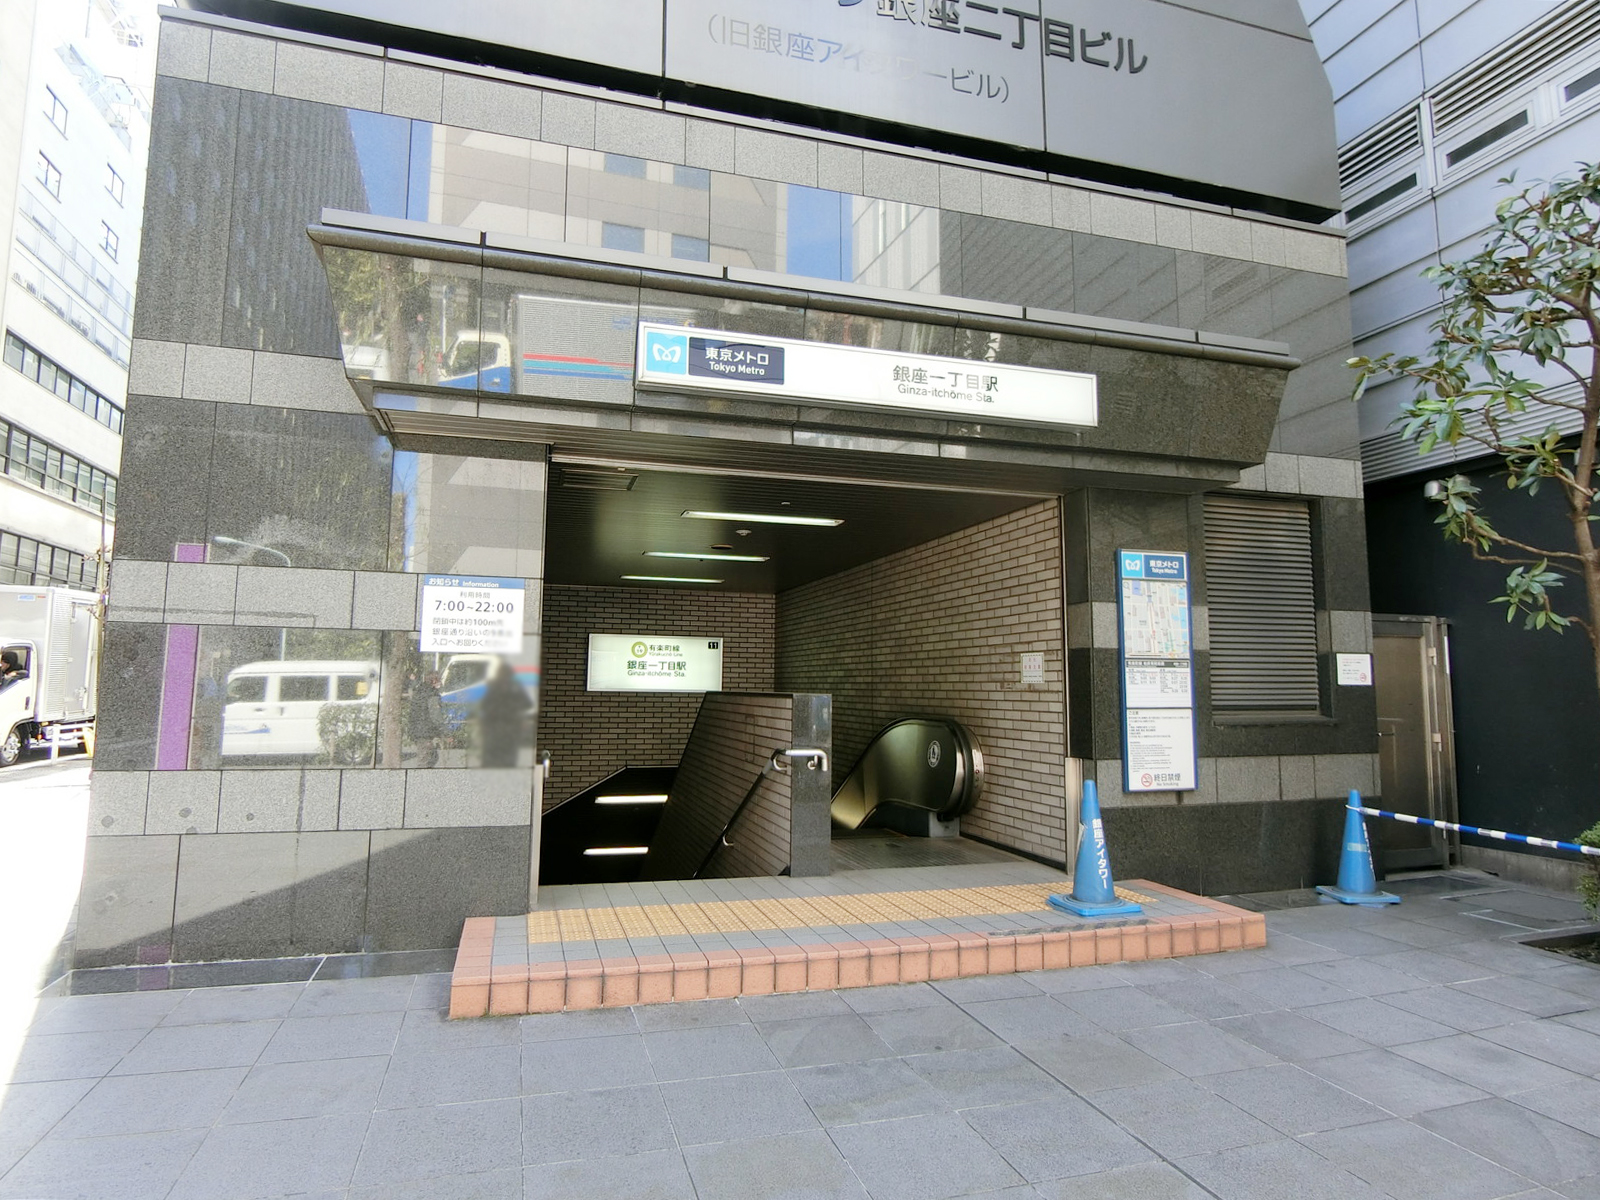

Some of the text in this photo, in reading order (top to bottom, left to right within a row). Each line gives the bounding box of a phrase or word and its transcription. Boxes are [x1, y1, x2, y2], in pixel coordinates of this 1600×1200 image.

[705, 347, 769, 365] 東京メトロ
[709, 361, 765, 376] Tokyo Metro
[893, 365, 999, 392] 銀座一丁目駅
[897, 384, 995, 403] Ginza-itchōme Sta.
[428, 577, 500, 588] お知らせ Information
[460, 591, 491, 599] 利用時間
[432, 628, 514, 638] 銀座通り沿いの
[431, 638, 509, 647] 入口へお回りく
[649, 644, 680, 652] 有楽町線
[626, 660, 687, 671] 銀座一丁目駅
[1154, 773, 1181, 782] 終日禁煙
